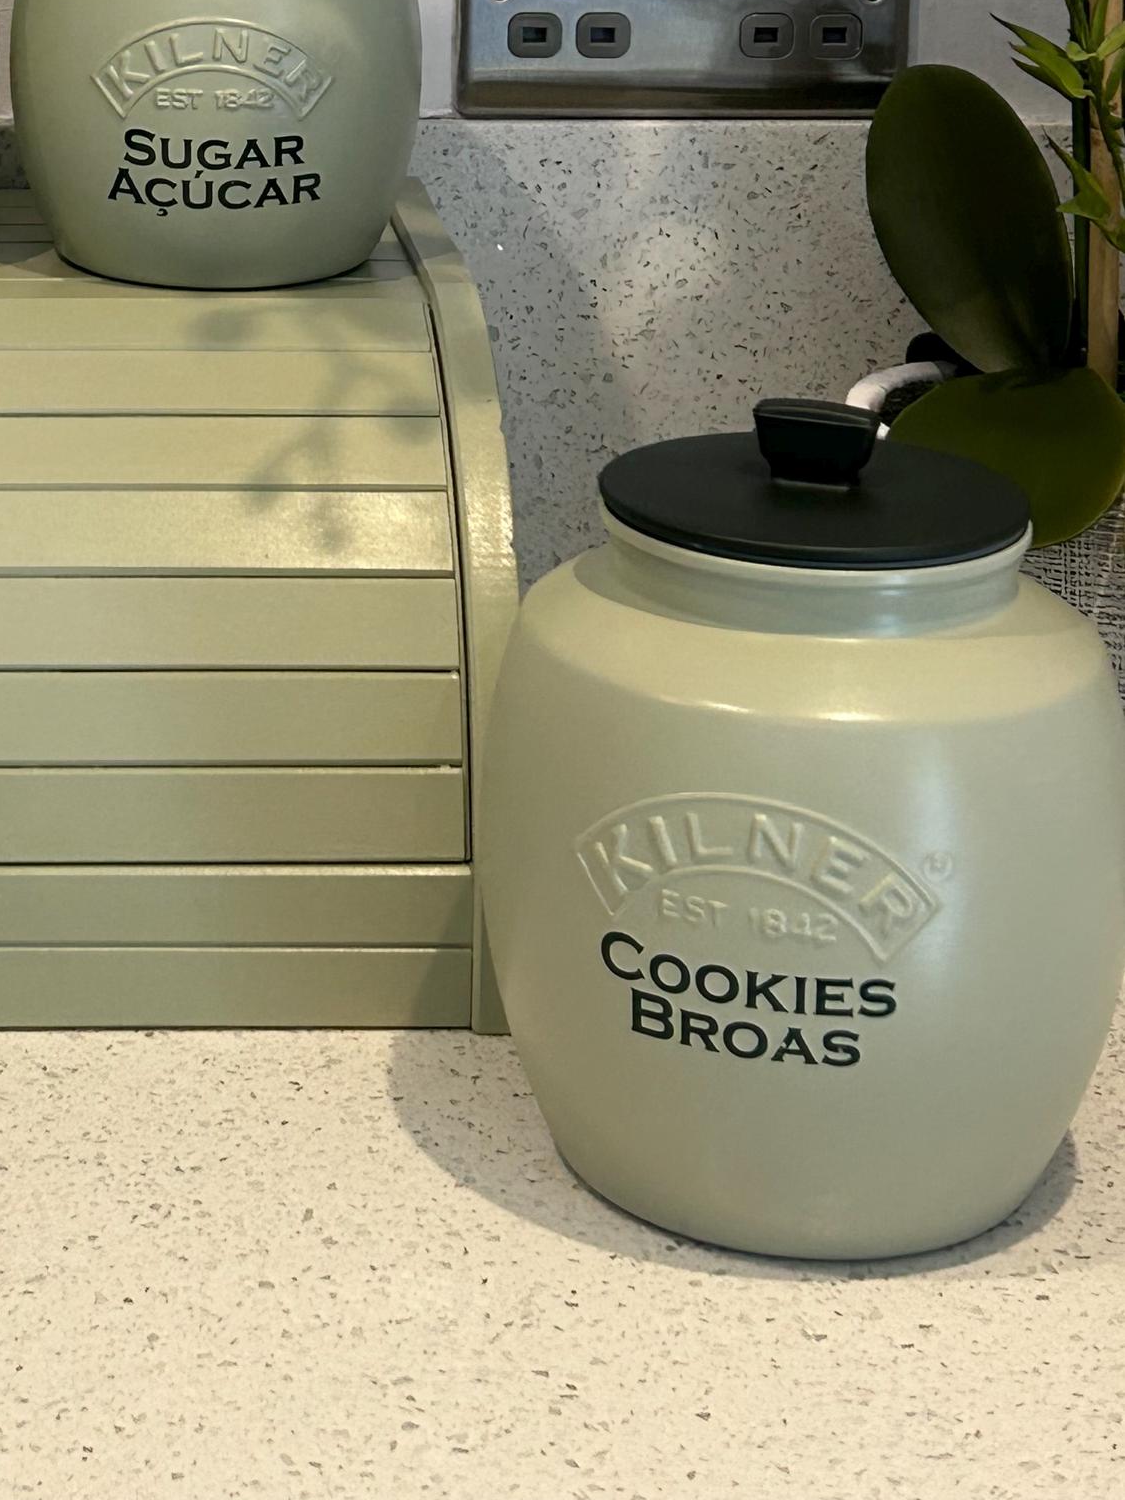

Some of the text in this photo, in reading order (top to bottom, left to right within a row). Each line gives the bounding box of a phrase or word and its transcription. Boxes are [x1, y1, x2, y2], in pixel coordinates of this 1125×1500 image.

[106, 26, 324, 104] KILNER
[155, 87, 275, 111] EST 1842
[123, 128, 305, 171] SUGAR
[107, 167, 322, 217] AÇÚCAR
[594, 811, 917, 940] KILNER
[658, 887, 840, 945] EST 1842
[600, 930, 898, 1019] COOKIES
[630, 986, 862, 1068] BROAS
